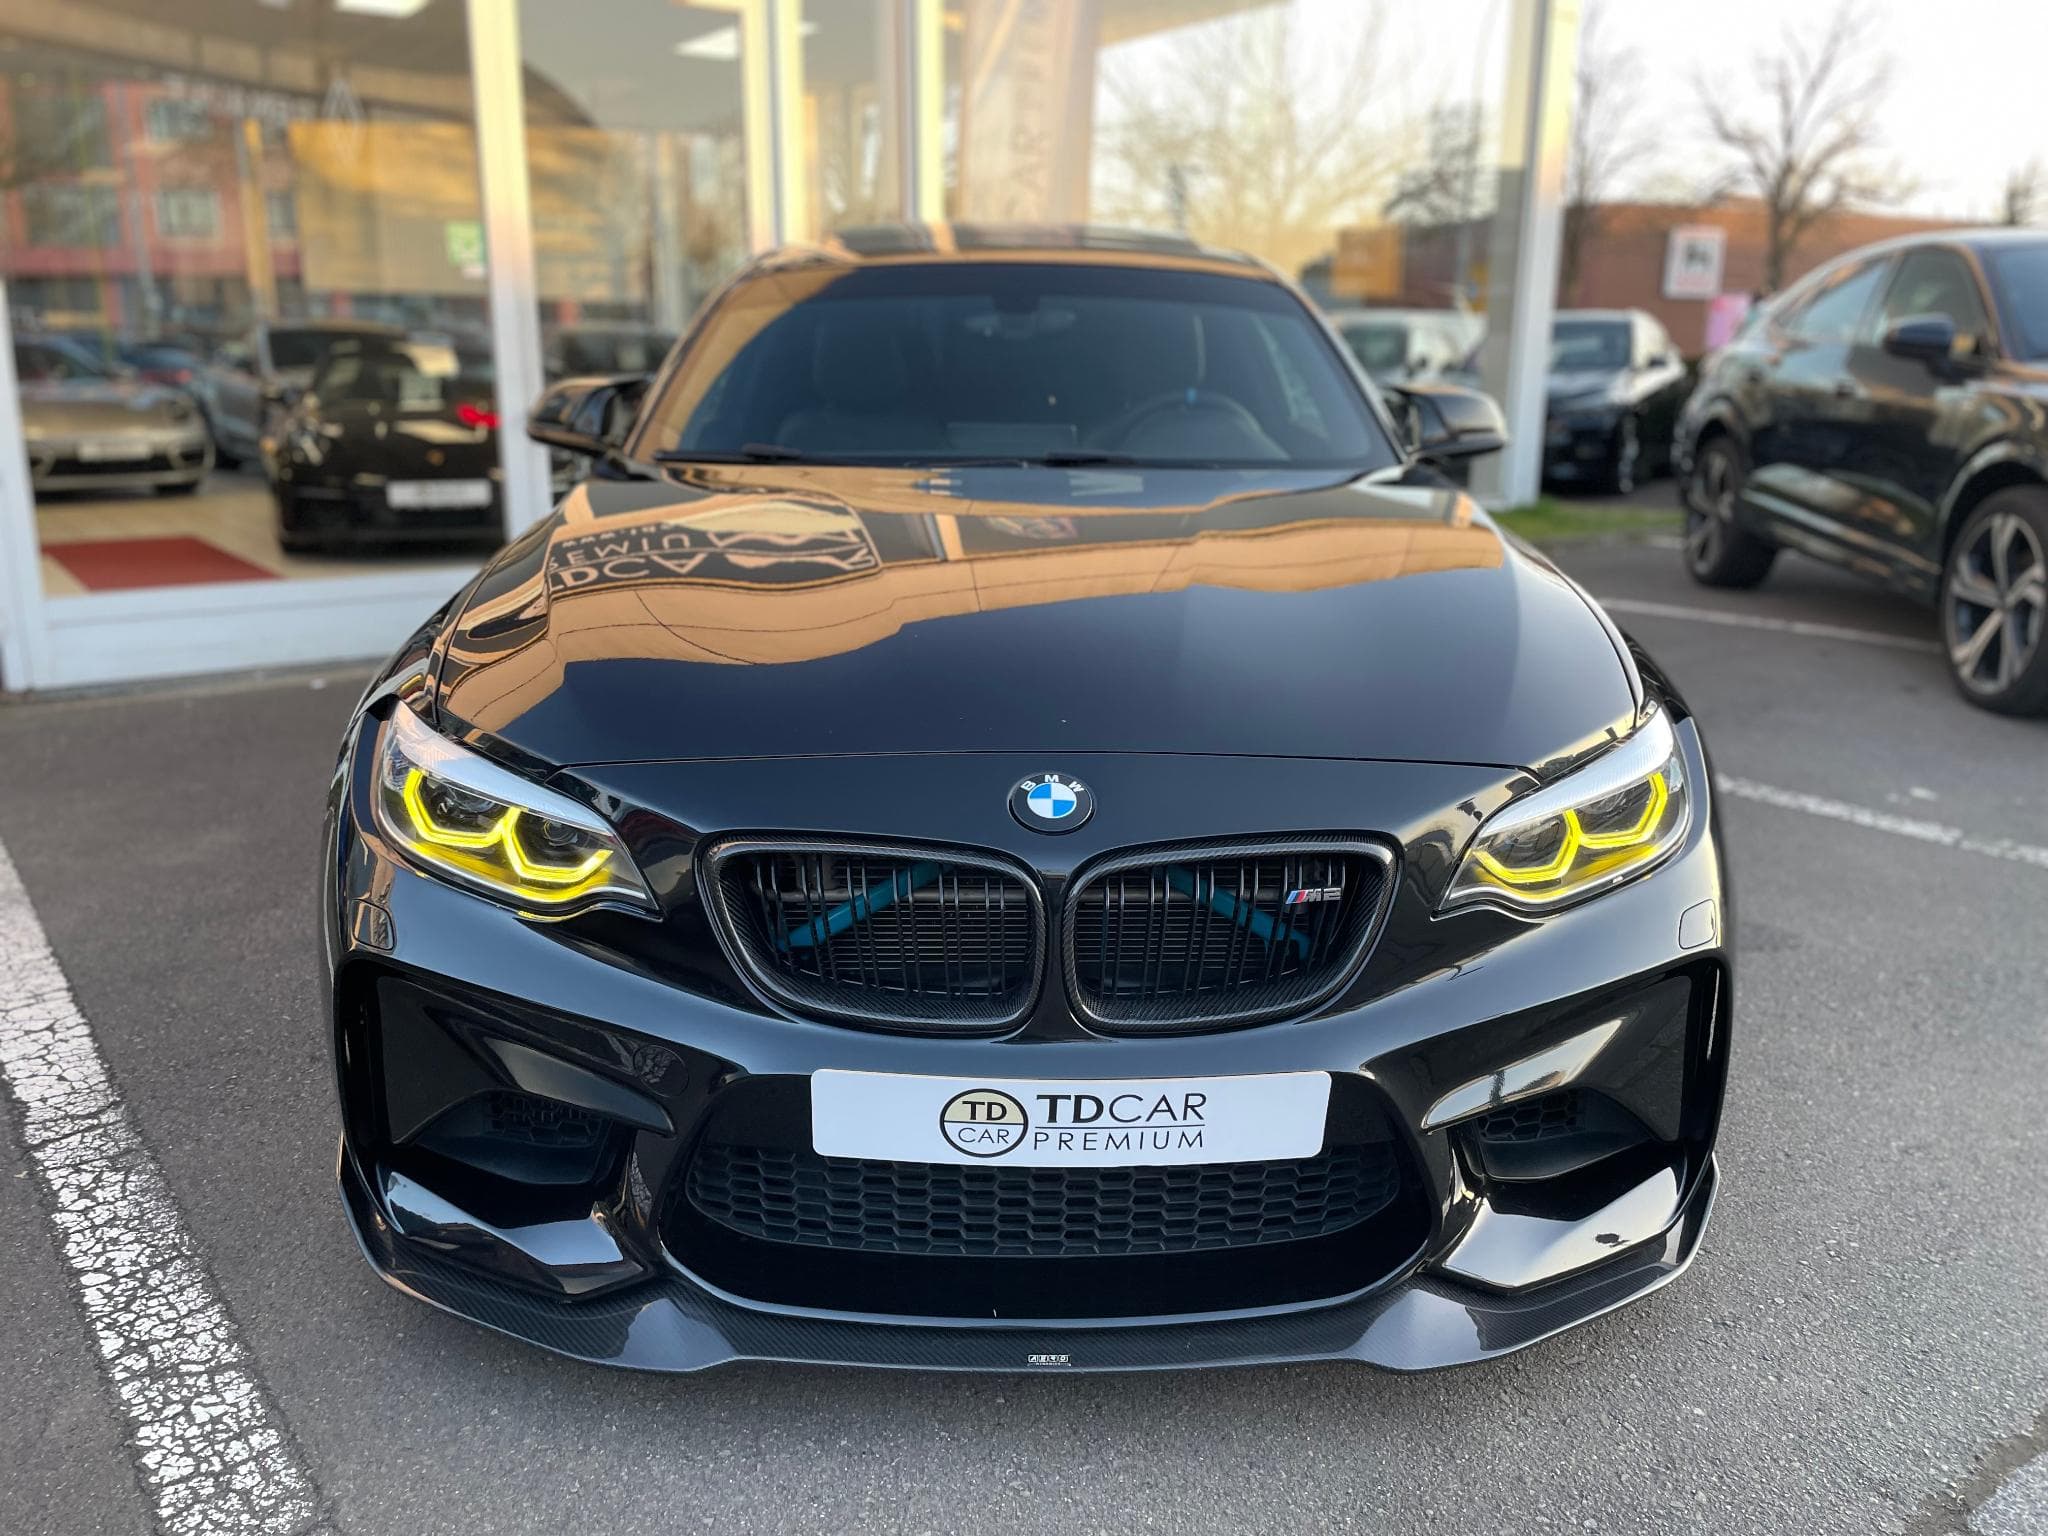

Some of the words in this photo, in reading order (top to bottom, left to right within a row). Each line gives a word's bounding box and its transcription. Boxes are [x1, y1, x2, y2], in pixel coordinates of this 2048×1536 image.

[1021, 774, 1085, 792] BMW
[1285, 887, 1342, 904] M2
[962, 1100, 1008, 1121] TD
[957, 1127, 1010, 1144] CAR
[1033, 1130, 1204, 1151] PREMIUM
